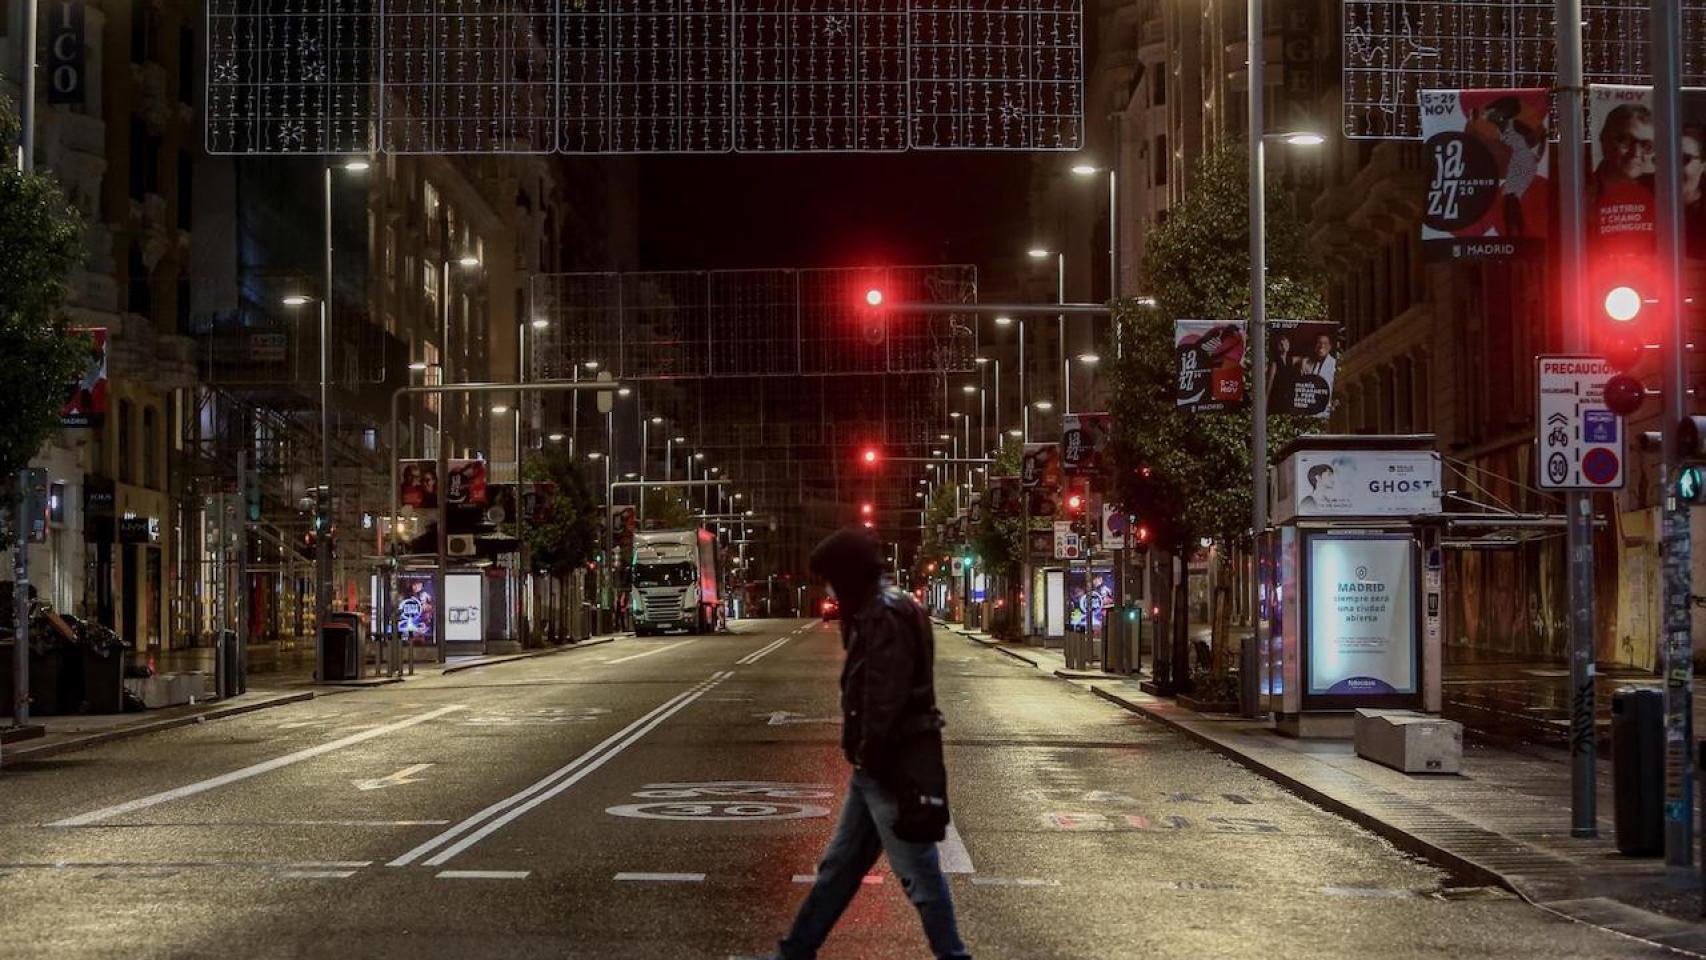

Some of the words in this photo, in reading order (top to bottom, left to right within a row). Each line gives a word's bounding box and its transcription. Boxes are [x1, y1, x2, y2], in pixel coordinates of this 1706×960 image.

[1425, 94, 1456, 104] 5-29
[1616, 90, 1645, 101] NOV
[1425, 104, 1455, 116] NOV
[1459, 186, 1475, 195] 20
[1600, 204, 1646, 214] MARTIRIO
[1608, 213, 1642, 224] CHANO
[1466, 243, 1515, 256] MADRID
[1220, 385, 1238, 393] NOV
[1552, 460, 1564, 477] 30
[1369, 480, 1433, 493] GHOST
[1337, 583, 1386, 592] MADRID
[1334, 595, 1369, 603] siempre
[1356, 604, 1386, 612] ciudad
[1345, 614, 1378, 622] abierta
